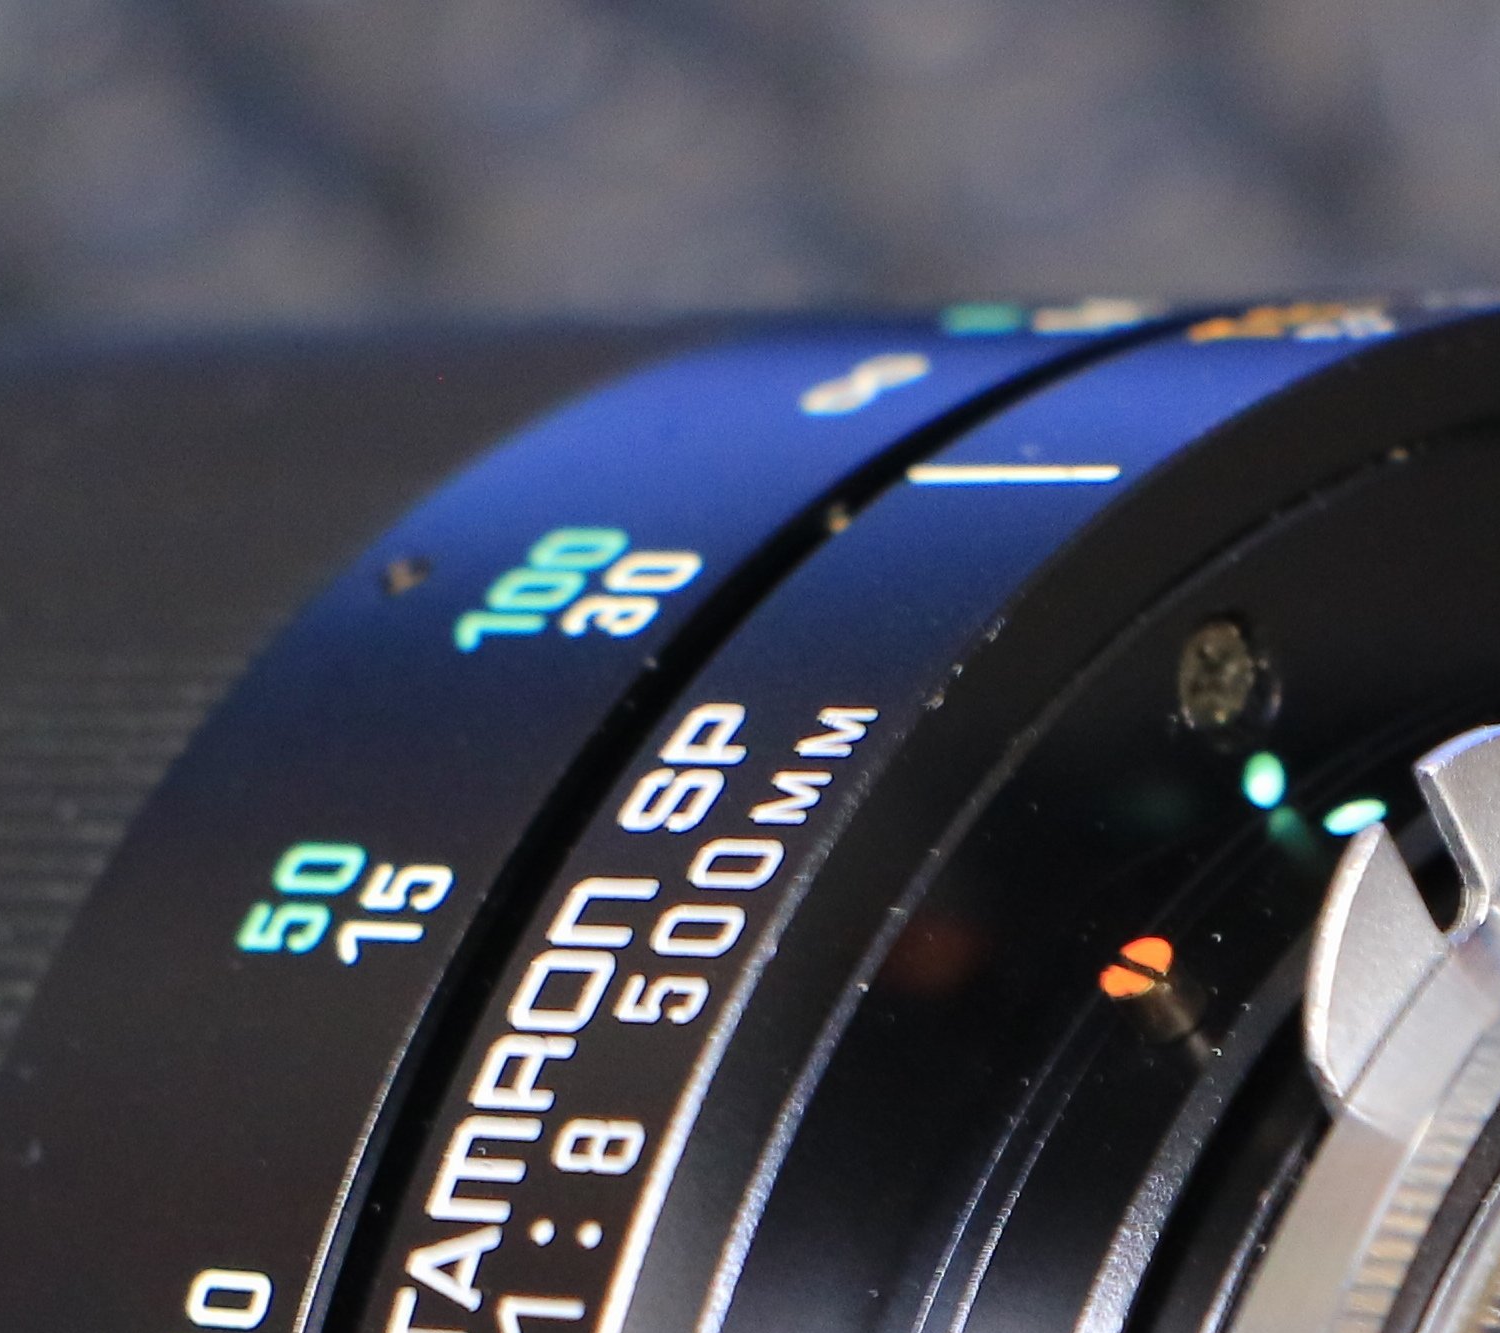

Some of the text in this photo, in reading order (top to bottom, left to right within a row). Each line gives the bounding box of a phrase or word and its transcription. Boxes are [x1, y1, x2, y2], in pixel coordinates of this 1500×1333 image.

[454, 524, 629, 651] 100
[562, 545, 705, 638] 30
[619, 703, 746, 832] SP
[237, 843, 367, 954] 50
[337, 863, 454, 965] 15
